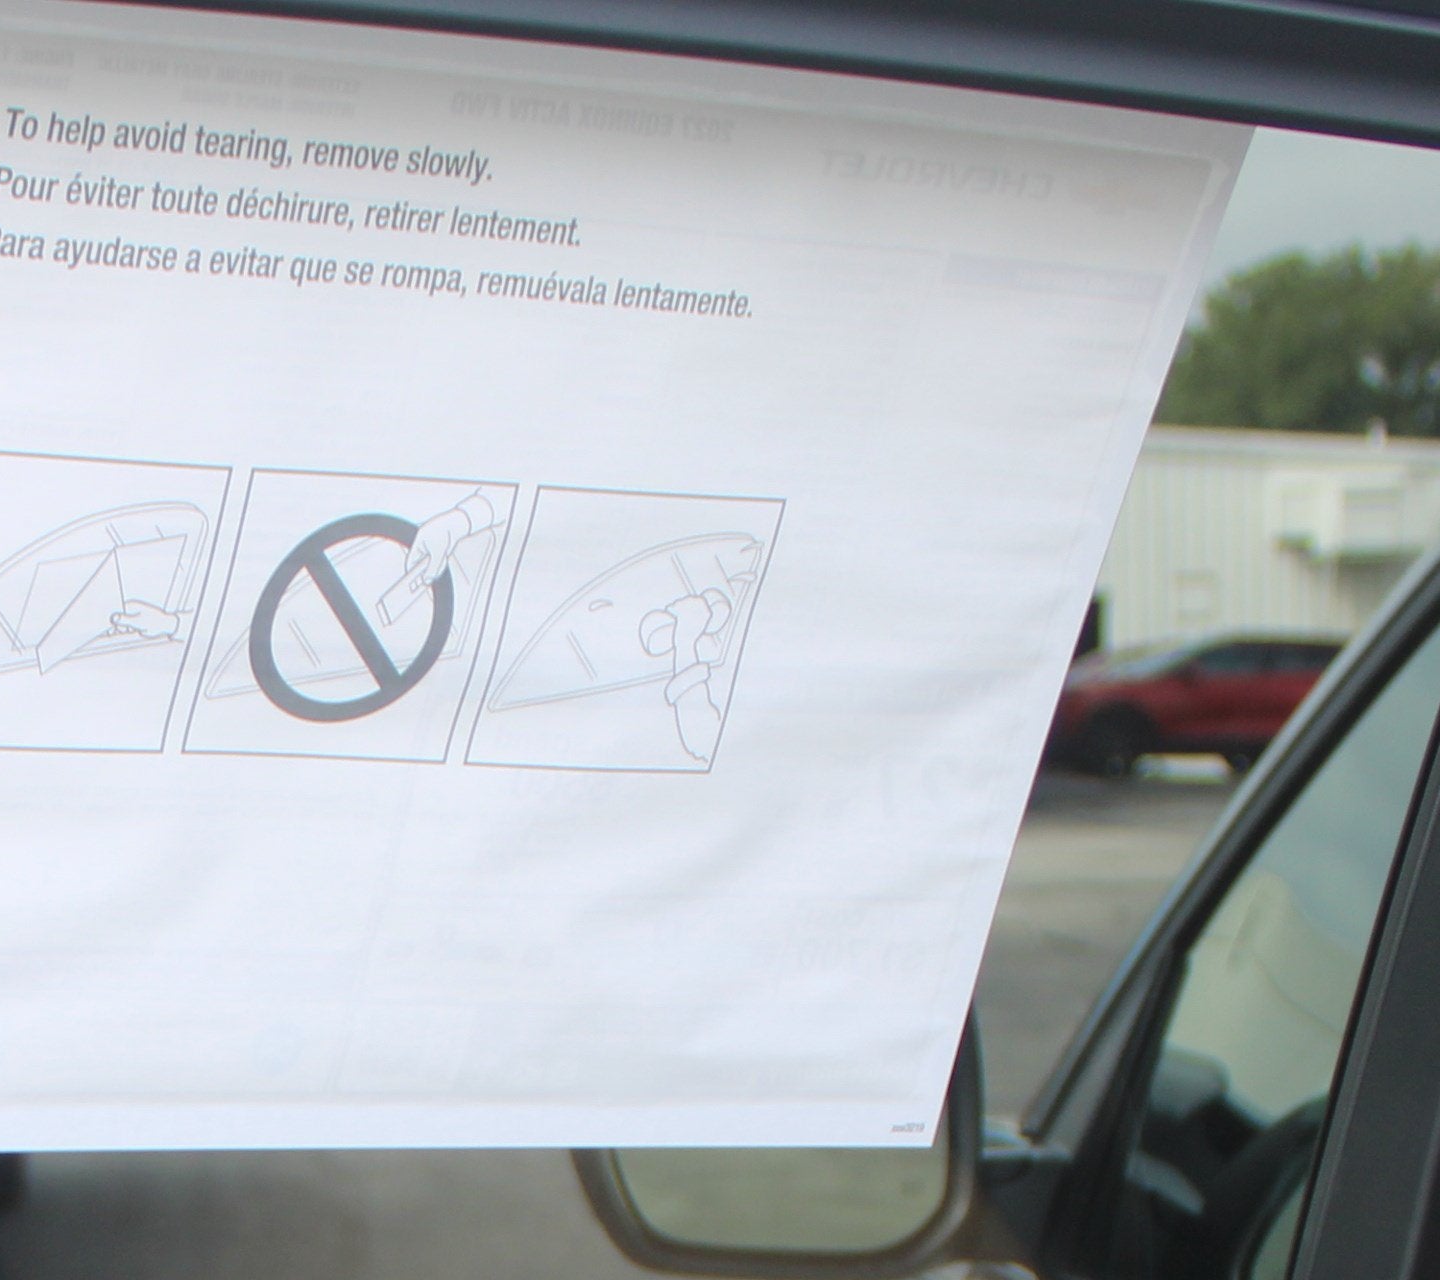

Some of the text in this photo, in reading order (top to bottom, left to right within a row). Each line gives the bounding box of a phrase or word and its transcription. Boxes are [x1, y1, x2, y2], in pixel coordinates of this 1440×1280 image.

[5, 106, 493, 187] To help avoid tearing, remove slowly.
[65, 171, 146, 211] éviter
[151, 180, 219, 217] toute
[225, 186, 355, 232] déchirure,
[363, 200, 446, 235] retirer
[448, 204, 581, 248] lentement.
[52, 235, 178, 273] ayudarse
[184, 248, 202, 274] a
[208, 245, 285, 279] evitar
[289, 256, 338, 288] que
[343, 260, 375, 287] se
[380, 263, 467, 299] rompa,
[476, 269, 608, 306] remuévala
[612, 277, 753, 319] lentamente.
